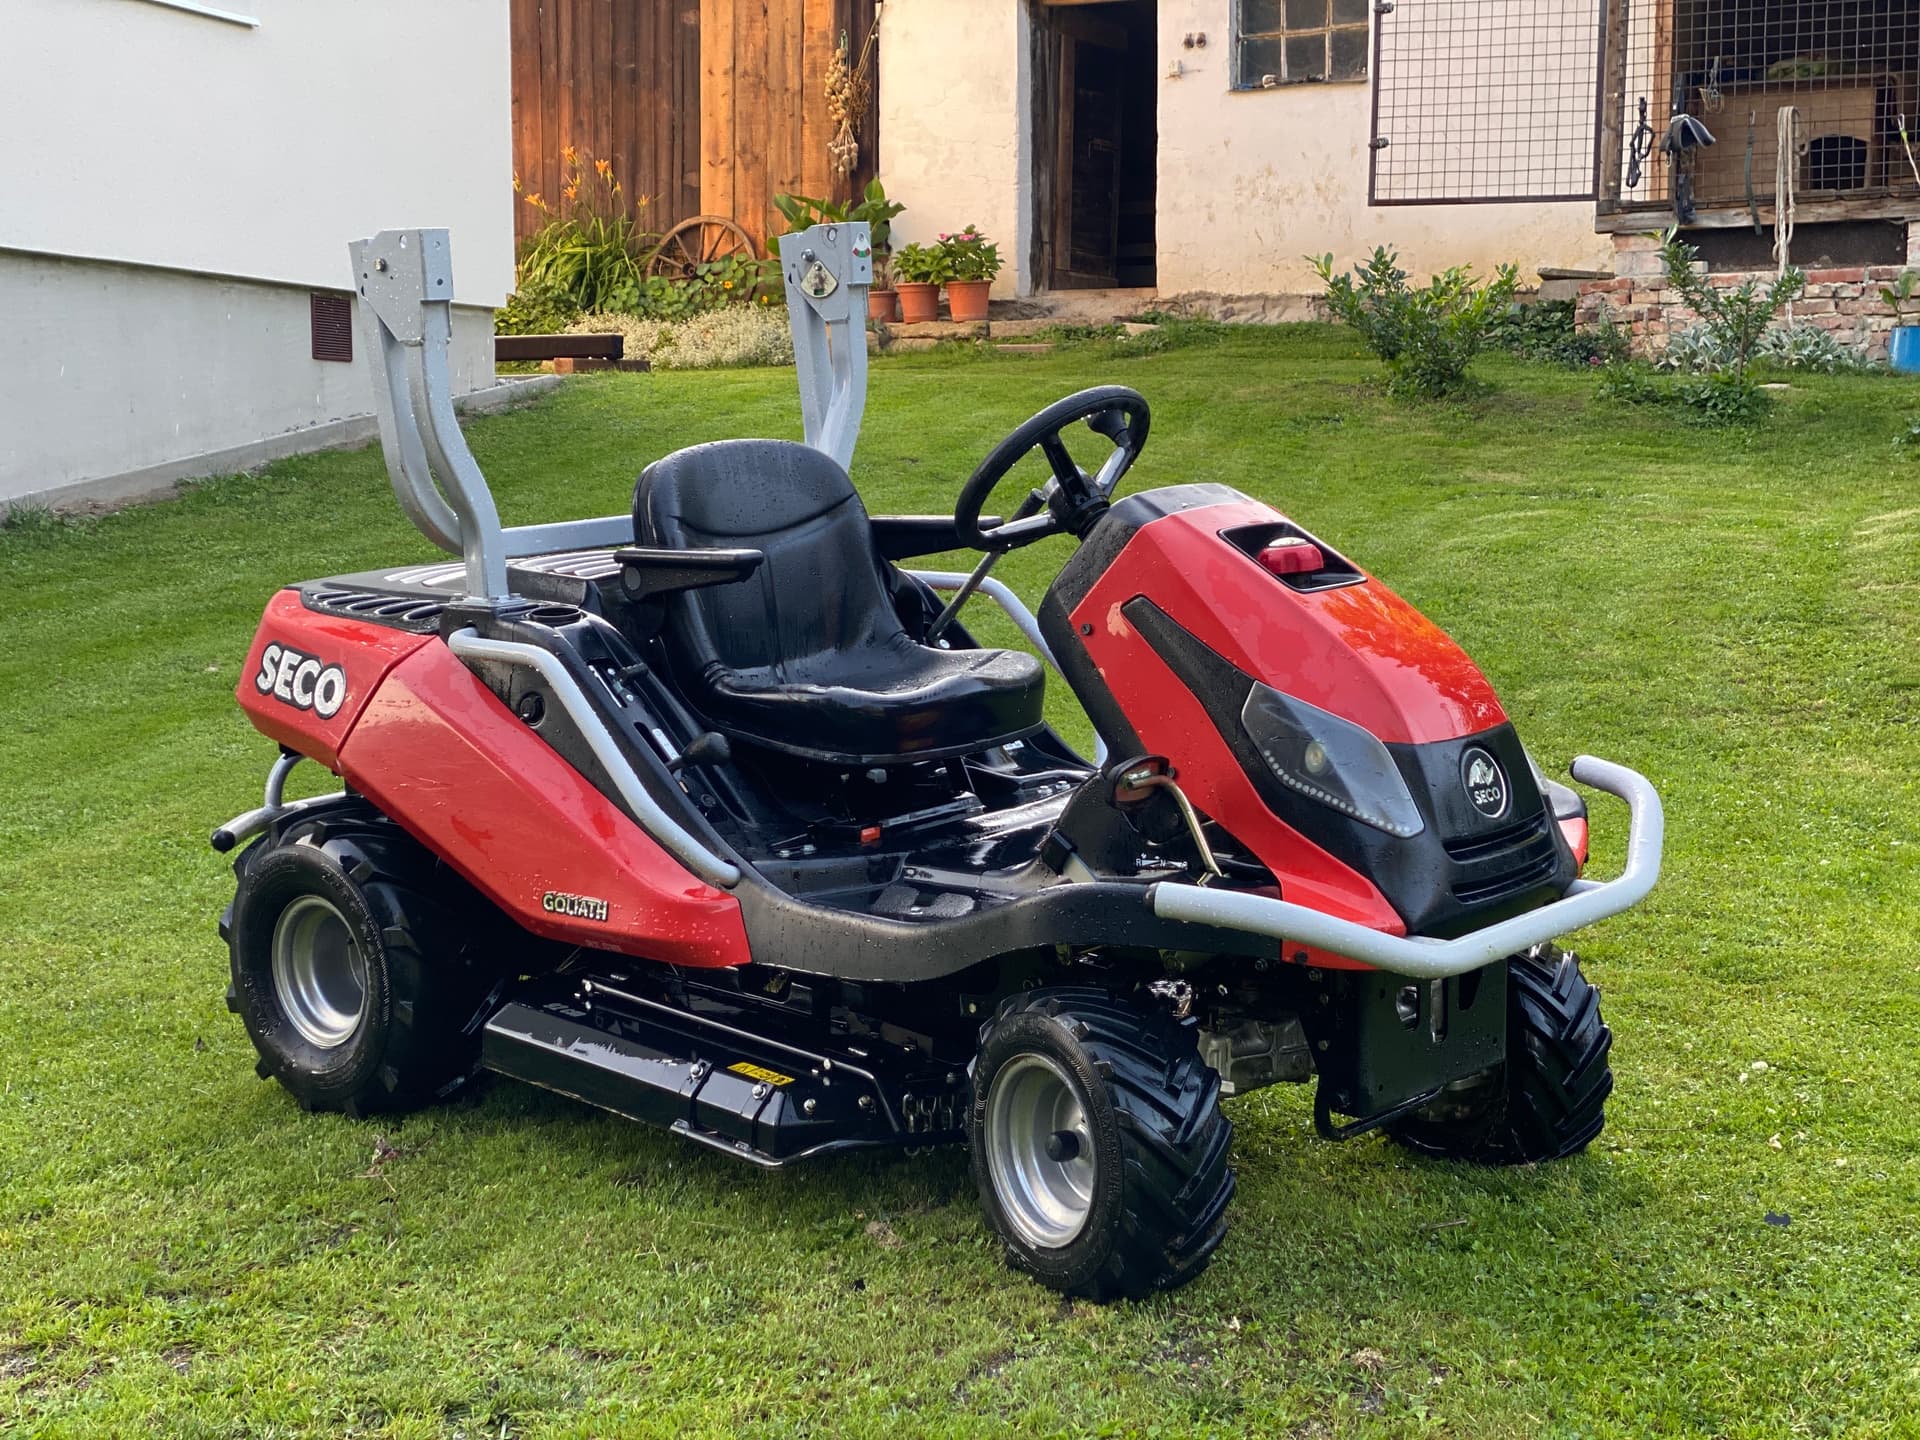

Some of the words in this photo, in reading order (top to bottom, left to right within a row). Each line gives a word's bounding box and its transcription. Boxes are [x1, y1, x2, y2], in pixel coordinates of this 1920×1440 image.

[256, 643, 346, 715] SECO
[1473, 787, 1501, 805] SECO
[542, 894, 608, 921] GOLIATH
